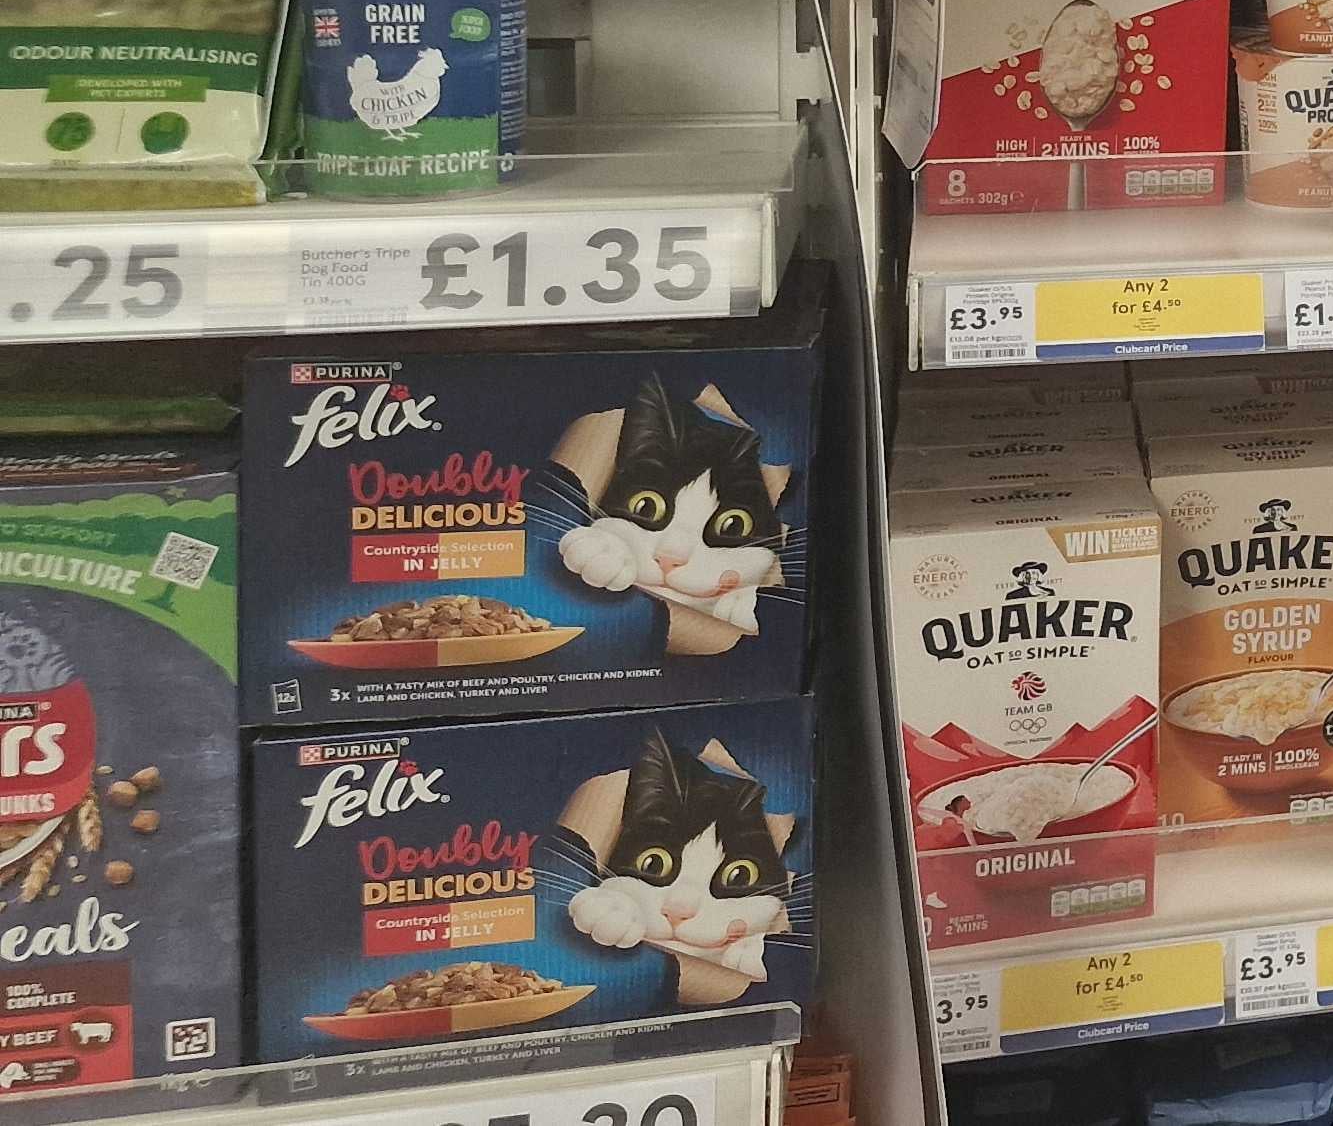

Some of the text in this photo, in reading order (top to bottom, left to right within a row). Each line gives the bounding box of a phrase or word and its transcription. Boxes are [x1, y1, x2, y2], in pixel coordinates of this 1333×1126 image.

[1299, 33, 1332, 43] PEANUT
[12, 45, 258, 68] ODOUR NEUTRALISING
[302, 247, 411, 261] Butcher's Tripe
[302, 262, 368, 275] Dog Food
[419, 227, 712, 310] £1.35
[301, 275, 366, 287] Tin 400G
[1123, 278, 1169, 295] Any 2
[1112, 299, 1136, 314] for
[314, 364, 388, 381] PURINA
[284, 384, 441, 467] felix
[349, 450, 531, 505] Doubly
[351, 501, 525, 530] DELICIOUS
[363, 540, 514, 557] Countryside Selection
[1063, 530, 1110, 557] WIN
[403, 555, 482, 572] IN JELLY
[922, 598, 1134, 660] QUAKER
[499, 688, 519, 696] AND
[522, 686, 547, 694] LIVER
[1004, 703, 1053, 717] TEAM GB
[975, 848, 1075, 877] ORIGINAL
